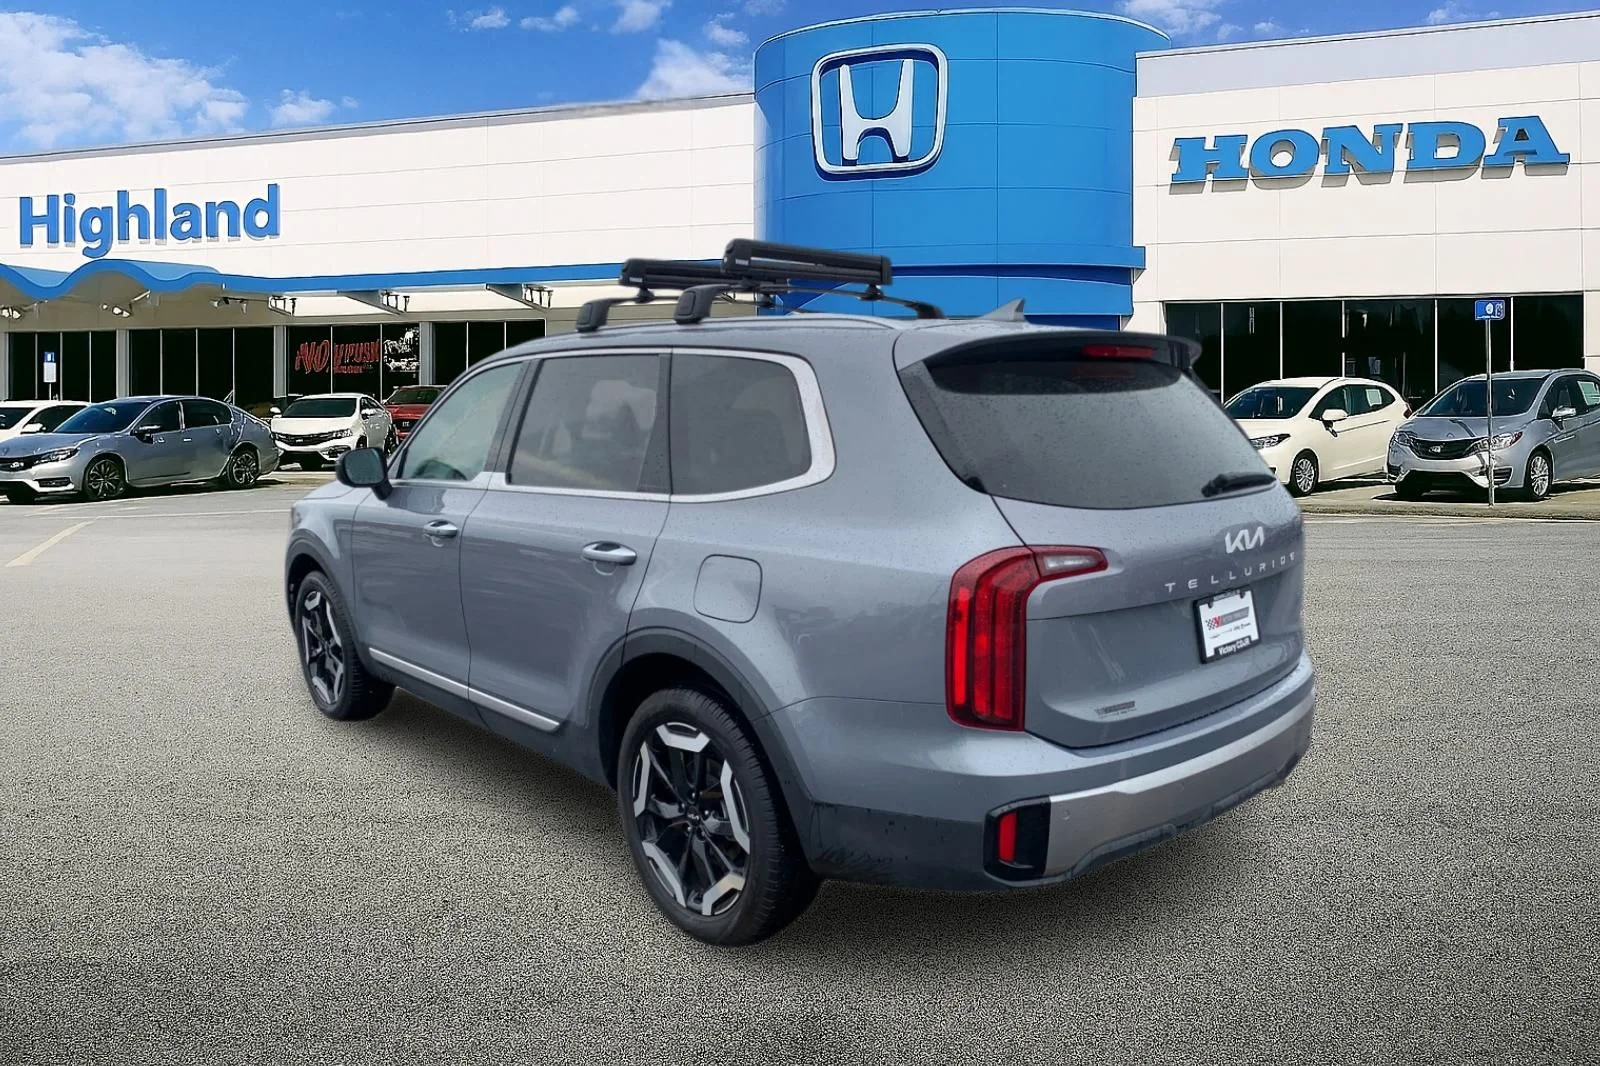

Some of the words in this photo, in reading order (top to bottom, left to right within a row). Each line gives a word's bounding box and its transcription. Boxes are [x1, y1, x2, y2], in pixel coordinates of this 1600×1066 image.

[1170, 115, 1571, 183] HONDA
[19, 183, 280, 258] Highland
[1224, 526, 1265, 554] KIA
[1164, 551, 1295, 593] TELLURIDE
